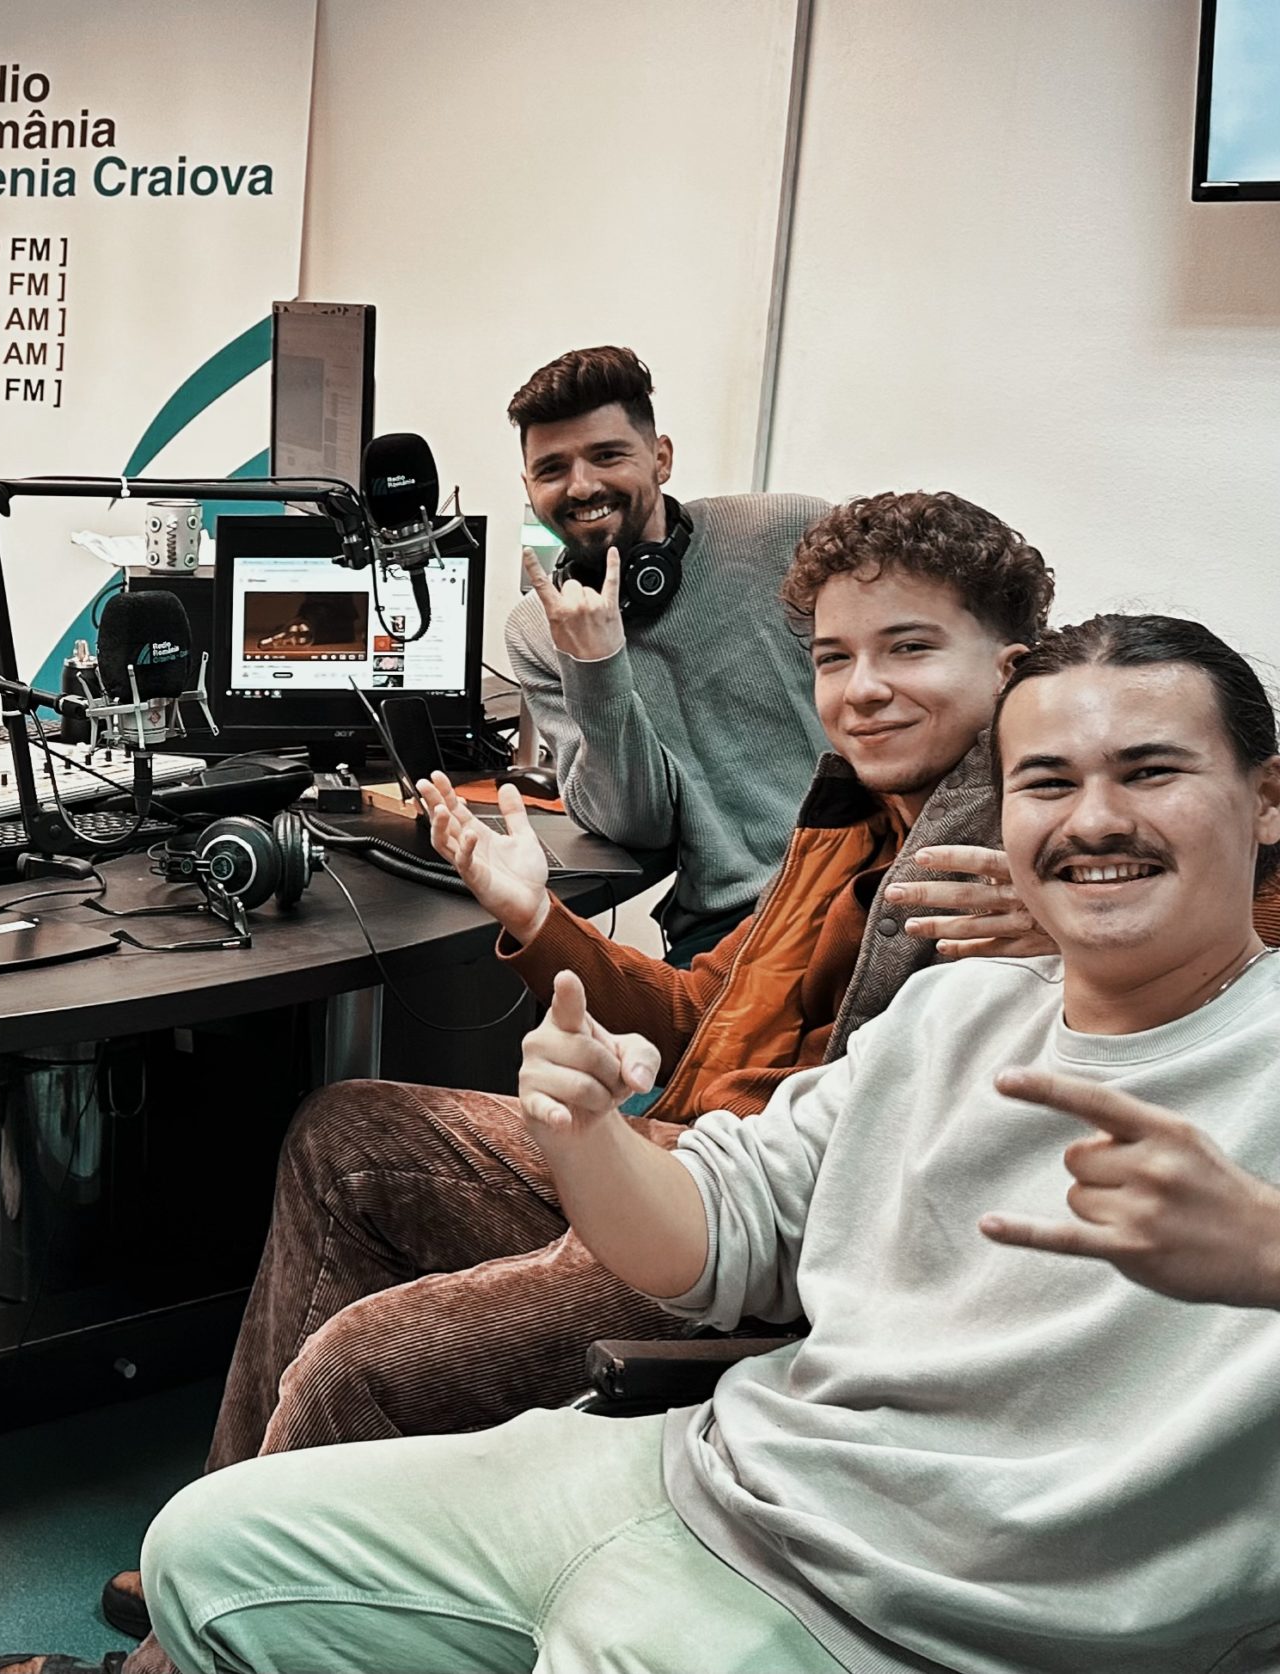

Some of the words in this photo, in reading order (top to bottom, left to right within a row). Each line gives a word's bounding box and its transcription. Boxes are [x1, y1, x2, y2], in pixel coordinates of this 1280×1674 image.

[93, 155, 273, 198] Craiova
[10, 237, 51, 262] FM
[9, 272, 49, 296] FM
[4, 307, 49, 331] AM
[3, 341, 48, 365] AM
[5, 378, 45, 402] FM
